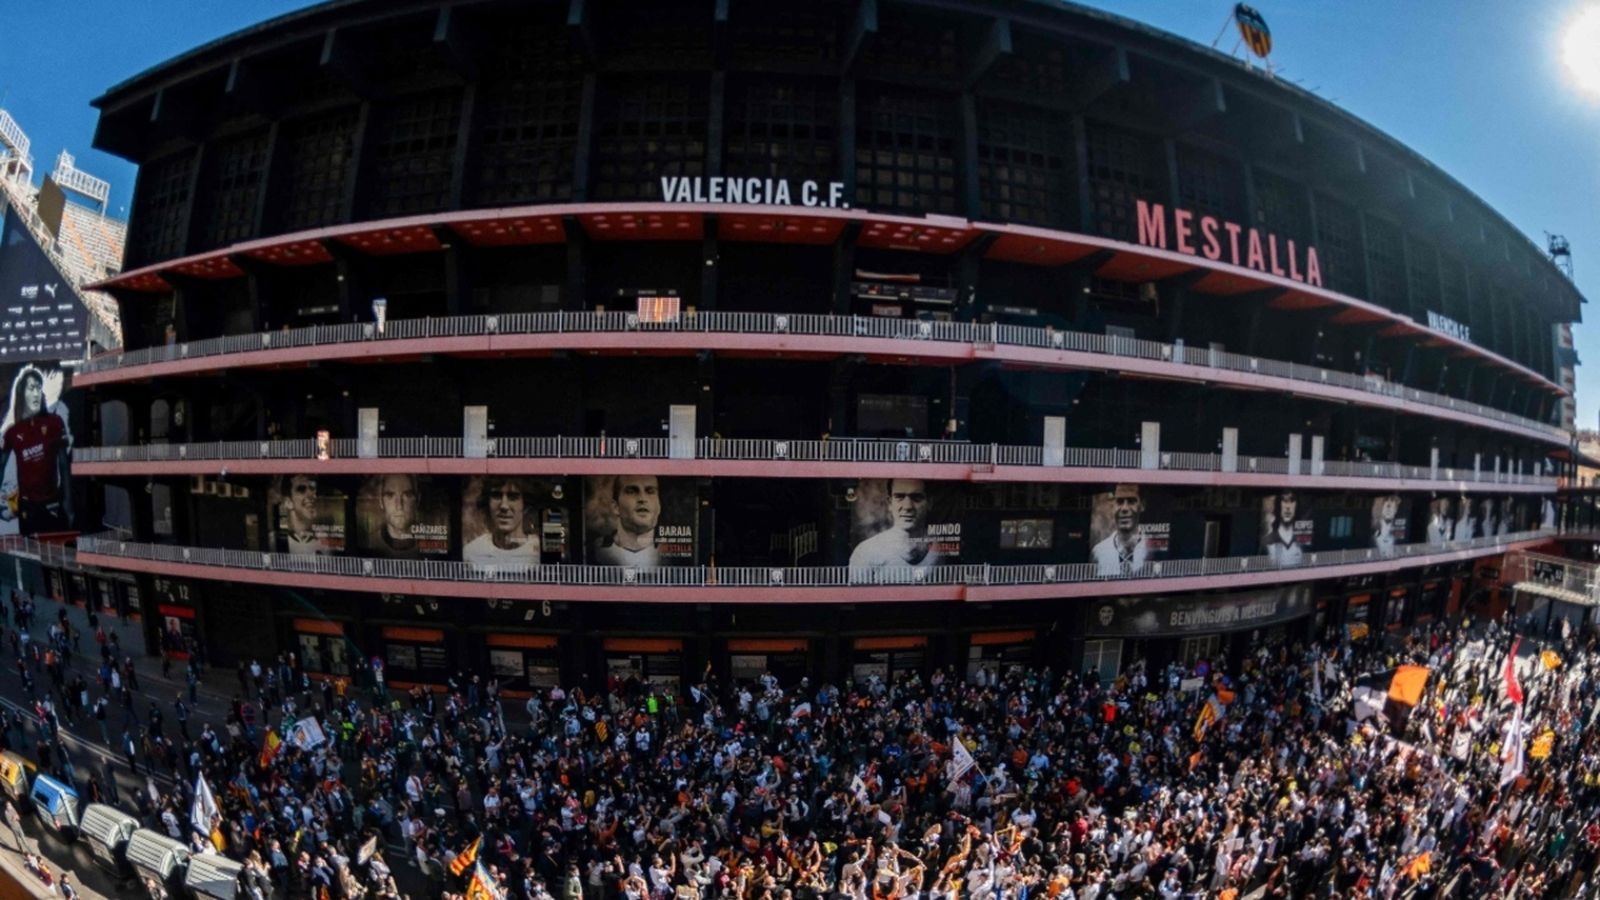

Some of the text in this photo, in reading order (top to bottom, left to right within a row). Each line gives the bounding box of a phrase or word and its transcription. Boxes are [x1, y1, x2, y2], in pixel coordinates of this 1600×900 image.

[660, 175, 850, 209] VALENCIA C.F.
[1136, 199, 1323, 288] MESTALLA
[1427, 309, 1459, 338] VALENCIA
[659, 526, 692, 537] BARAJA
[927, 523, 961, 535] MUNDO
[178, 584, 190, 600] 12
[541, 600, 552, 617] 6
